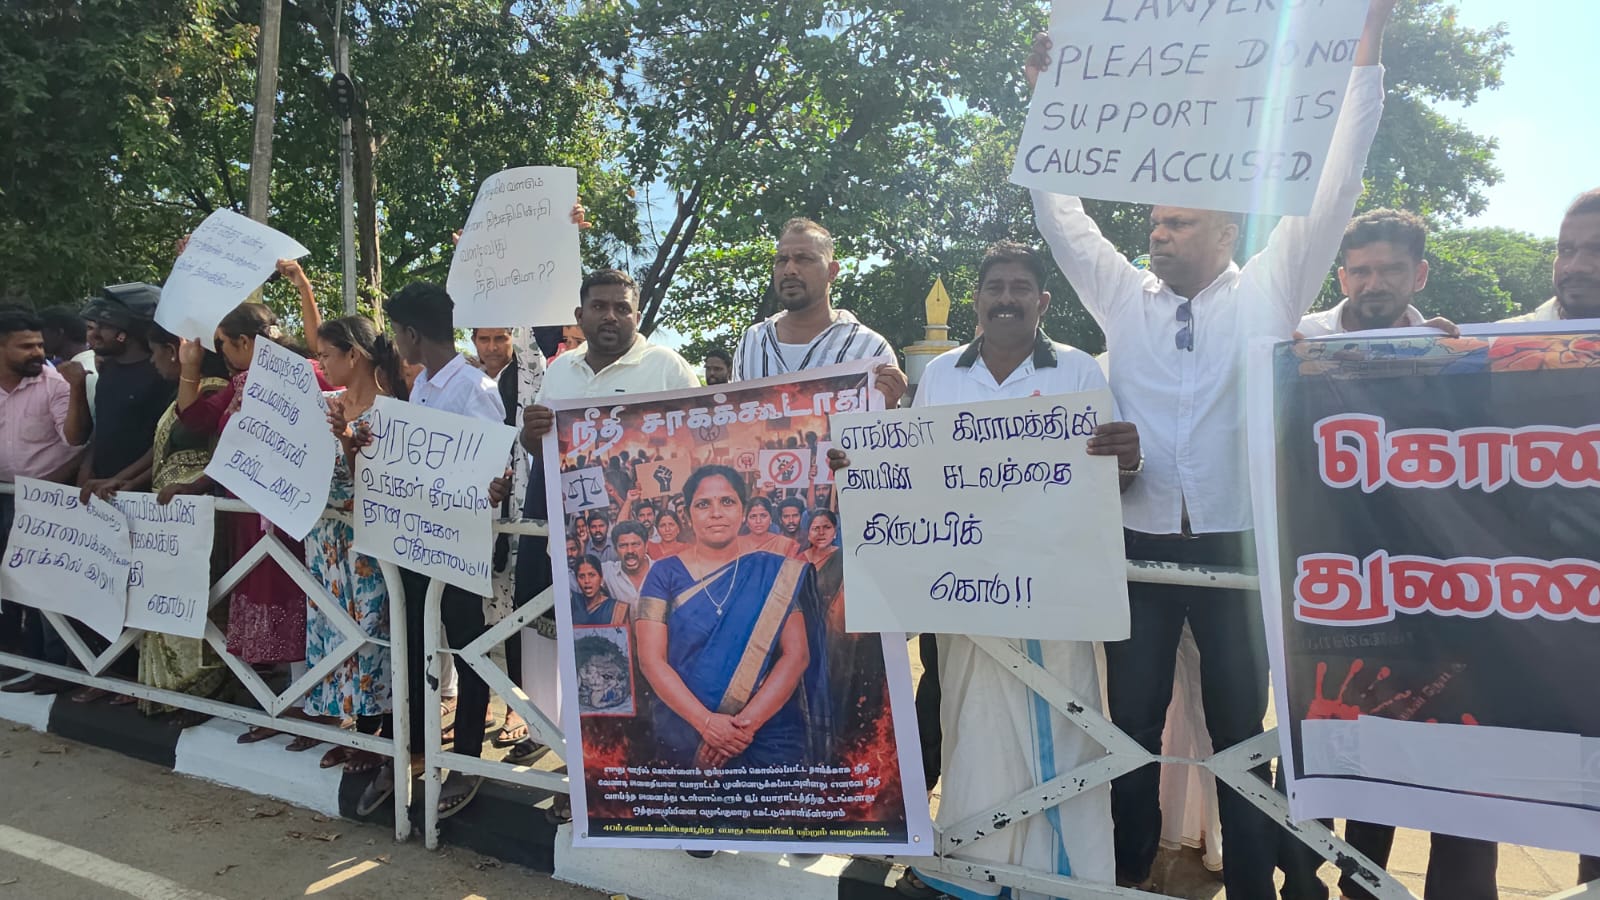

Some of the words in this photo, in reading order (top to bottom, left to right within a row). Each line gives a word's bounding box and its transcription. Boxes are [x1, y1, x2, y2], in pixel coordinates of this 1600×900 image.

[1055, 42, 1210, 87] PLEASE
[1235, 39, 1299, 69] DO
[1304, 38, 1360, 68] NOT
[1042, 100, 1217, 133] SUPPORT
[1024, 144, 1122, 176] CAUSE
[1130, 148, 1312, 183] ACCUSED.
[567, 404, 626, 456] நீதி
[840, 416, 935, 450] எங்கள்
[952, 405, 1098, 443] கிராமத்தின்
[361, 468, 425, 500] உங்கள்
[841, 461, 913, 493] தாயின்
[943, 457, 1072, 493] சடலத்தை
[23, 484, 79, 508] மனித
[855, 511, 983, 557] திருப்பிக்
[930, 571, 1033, 609] கொடு!!
